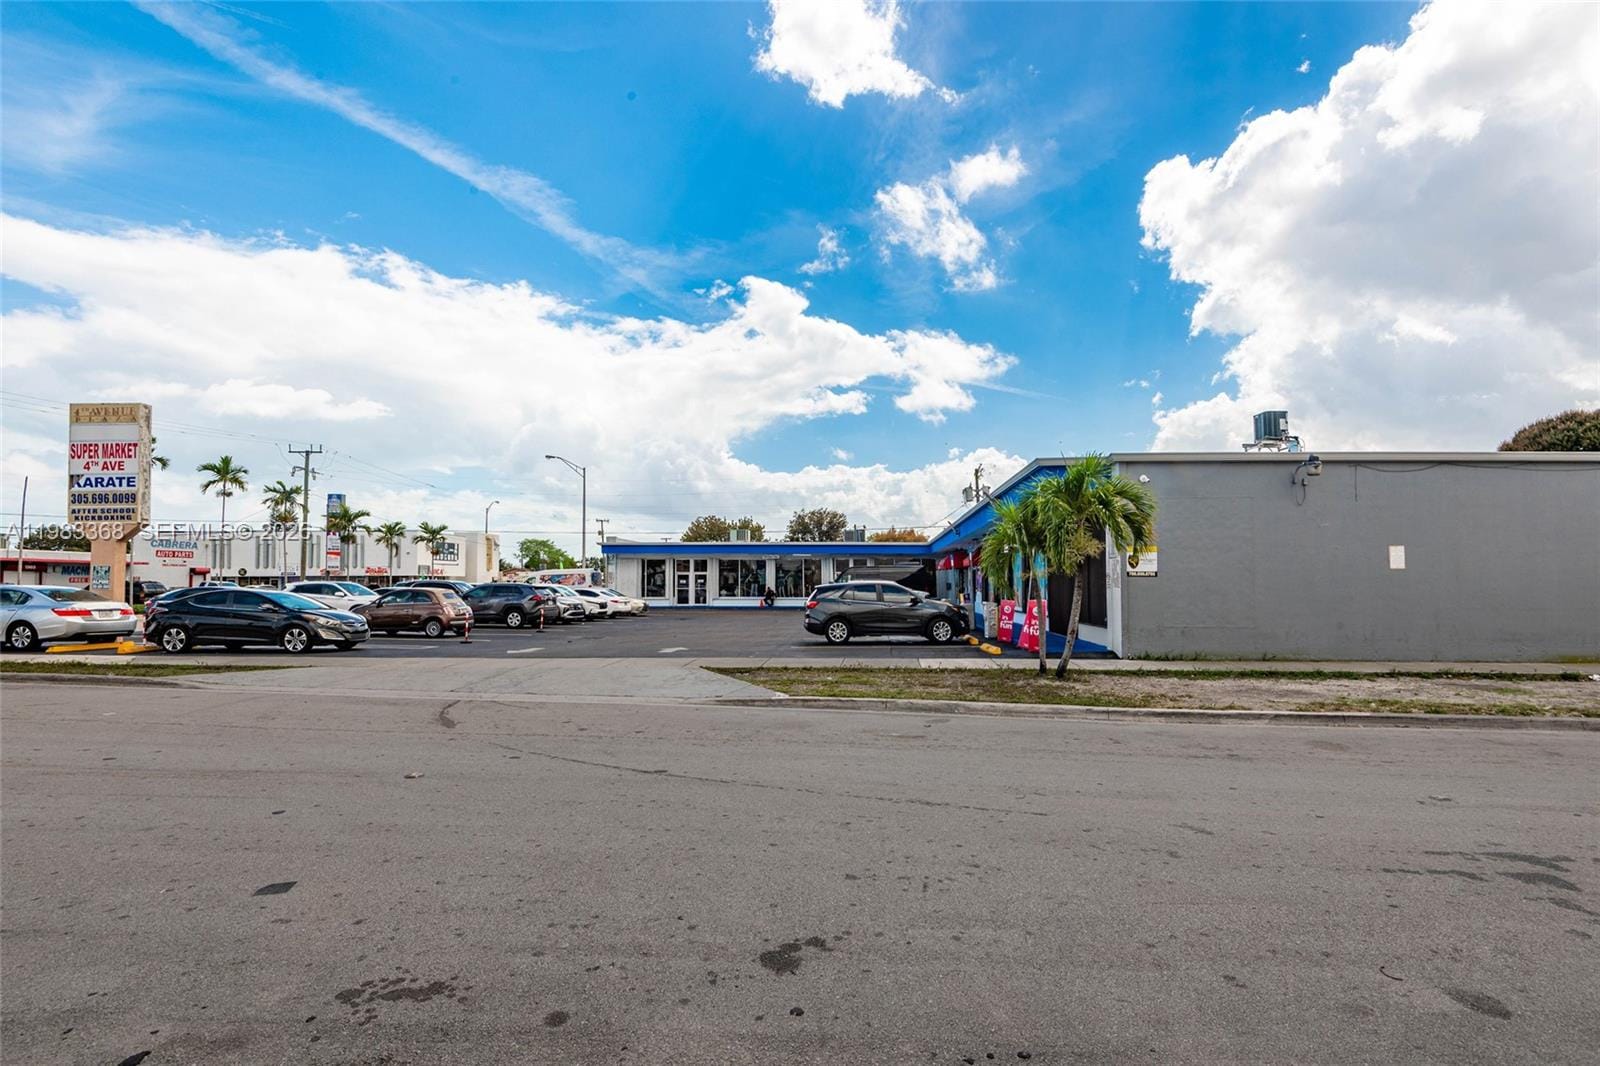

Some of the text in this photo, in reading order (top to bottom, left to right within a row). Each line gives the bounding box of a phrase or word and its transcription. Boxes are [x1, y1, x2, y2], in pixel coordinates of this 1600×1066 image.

[89, 407, 136, 416] AVENUE
[70, 443, 138, 459] SUPER MARKET
[83, 461, 125, 471] 4TH AVE
[71, 493, 136, 504] 305.696.0099
[150, 540, 198, 549] CABRERA
